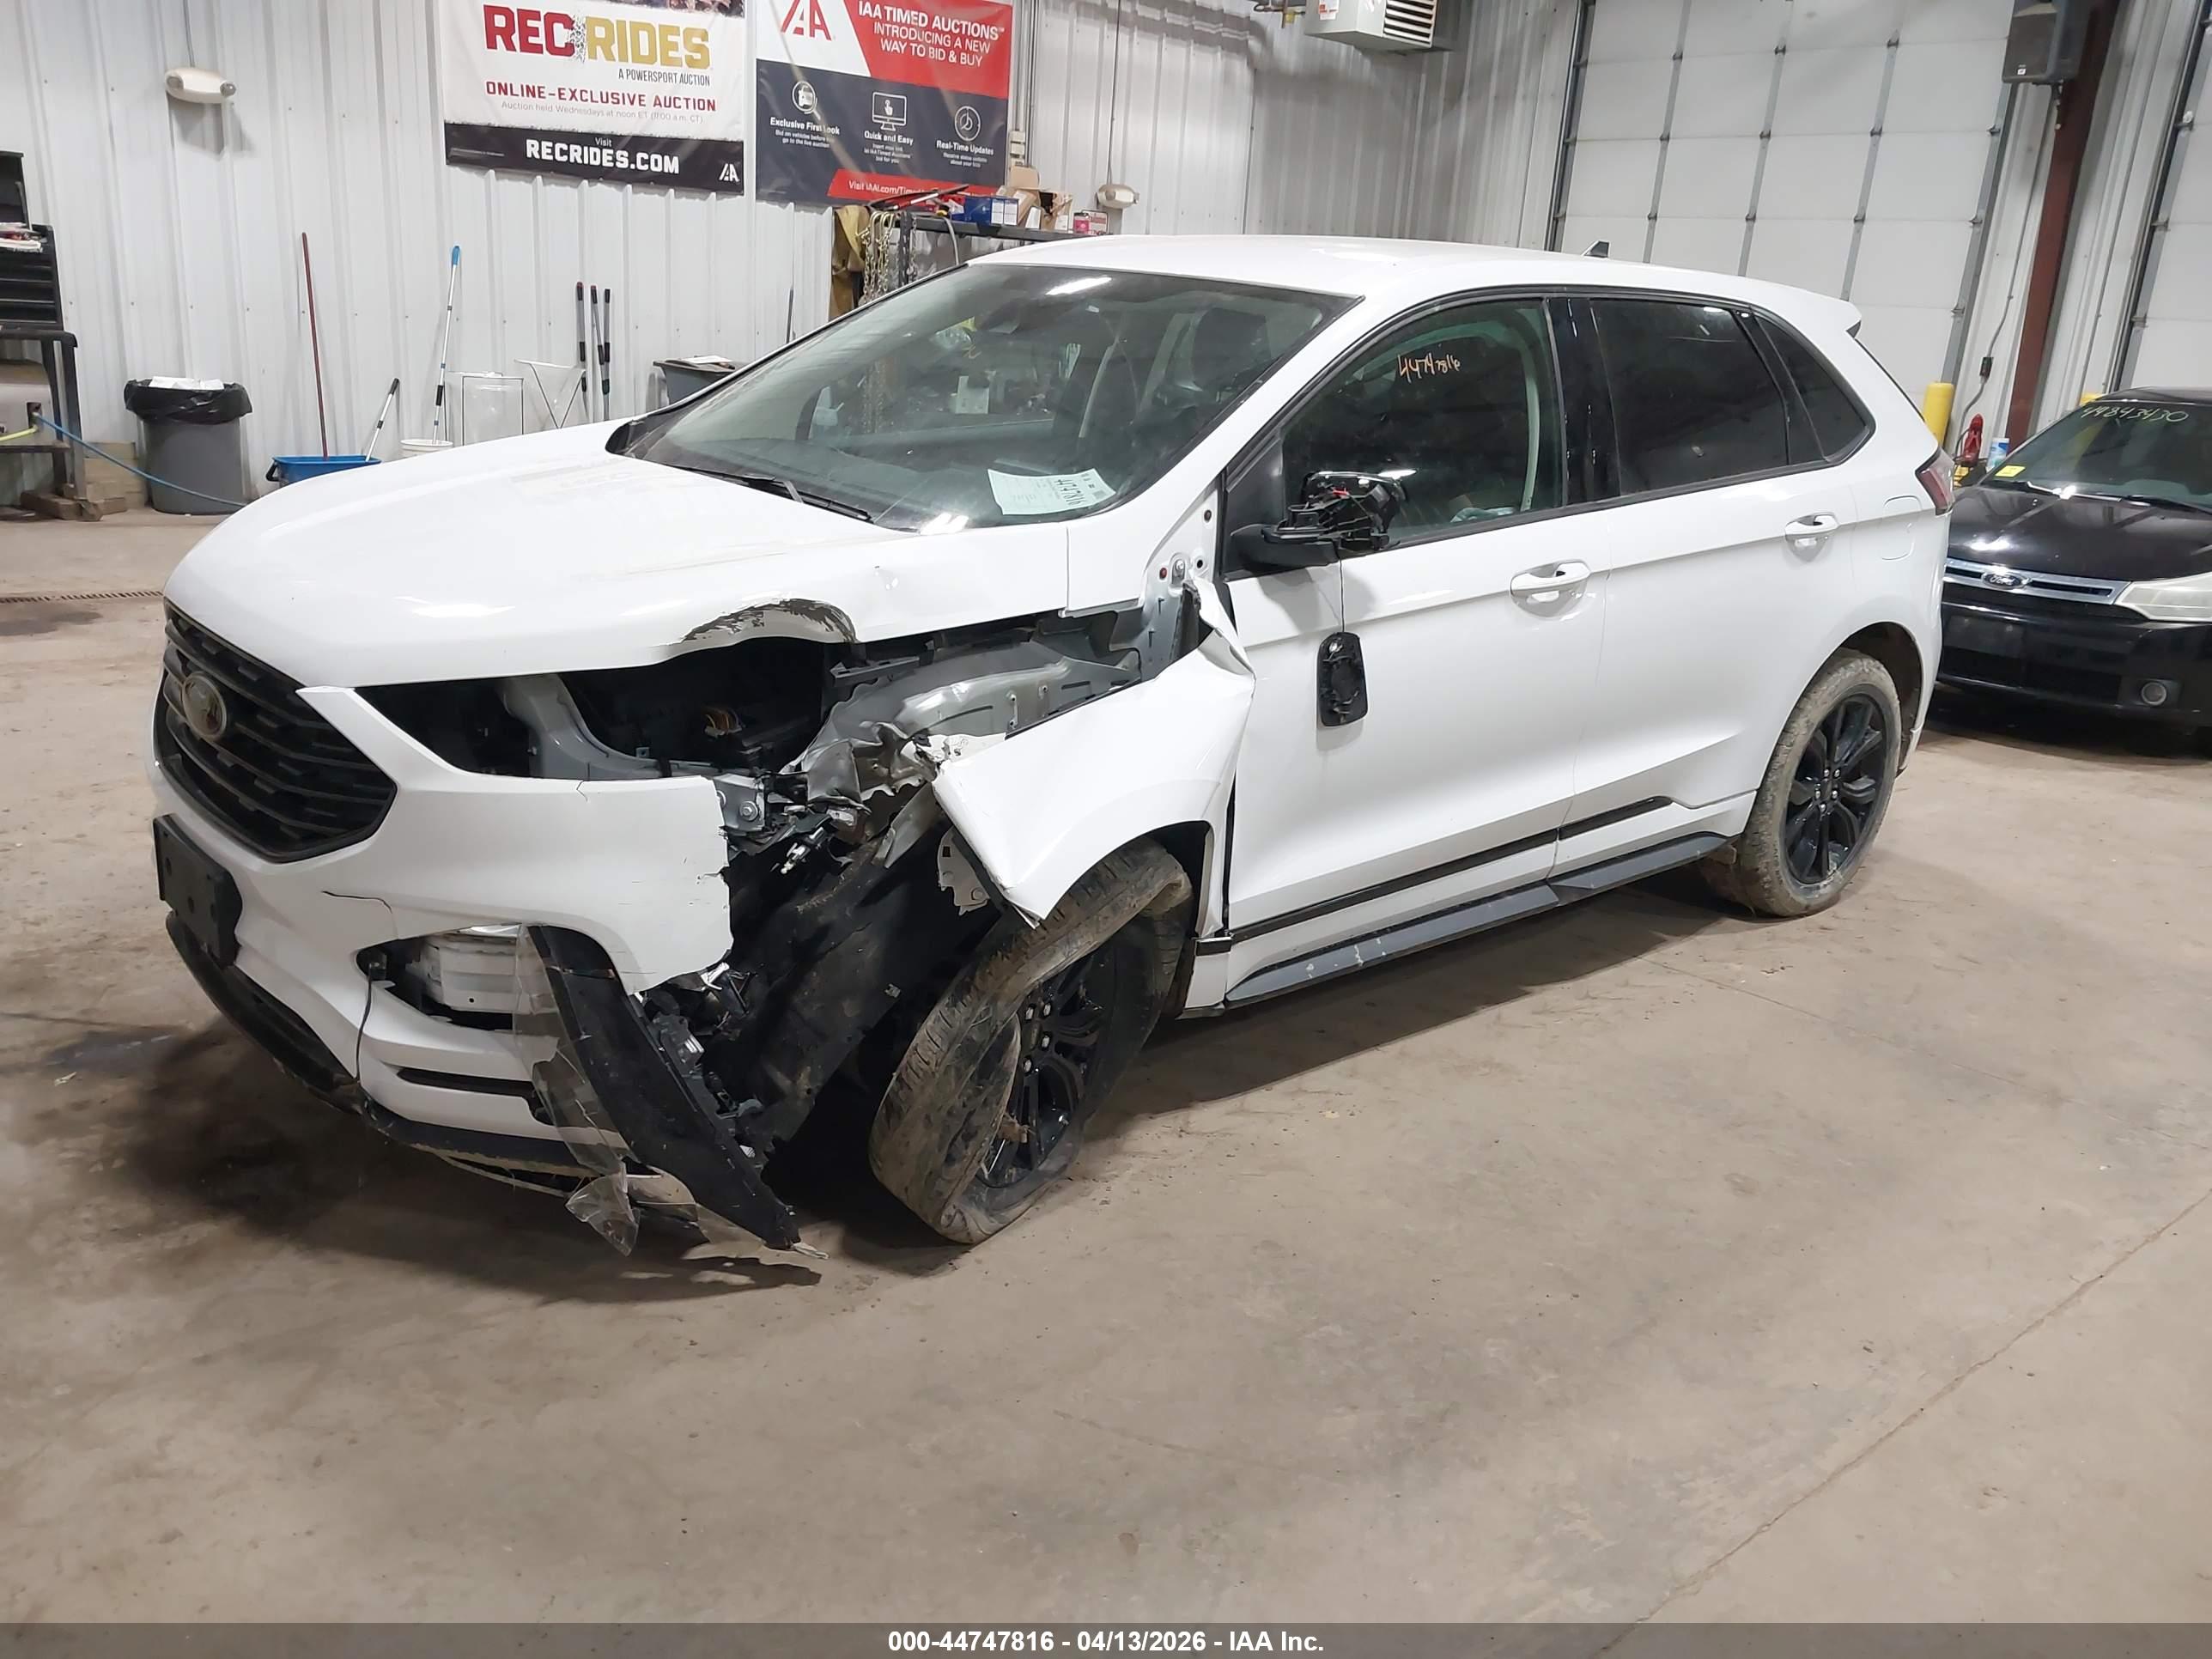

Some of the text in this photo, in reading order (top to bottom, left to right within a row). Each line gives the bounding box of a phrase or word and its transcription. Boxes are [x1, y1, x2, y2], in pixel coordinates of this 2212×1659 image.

[859, 1, 882, 20] IAA
[884, 6, 928, 27] TIMED
[586, 16, 711, 70] RIDES
[874, 21, 990, 54] INTRODUCING A NEW
[881, 40, 983, 67] WAY TO BID & BUY
[618, 69, 710, 86] A POWERSPORT AUCTION
[486, 82, 716, 111] ONLINE-EXCLUSIVE AUCTION
[501, 101, 533, 110] Auction
[535, 102, 552, 112] held
[556, 106, 605, 117] Wednesdays
[770, 117, 805, 129] Exclusive
[595, 137, 611, 147] Visit
[864, 131, 914, 146] Quick and Easy
[526, 138, 679, 174] RECRIDES.COM
[936, 140, 994, 155] Real-Time Updates
[849, 179, 865, 190] Visit
